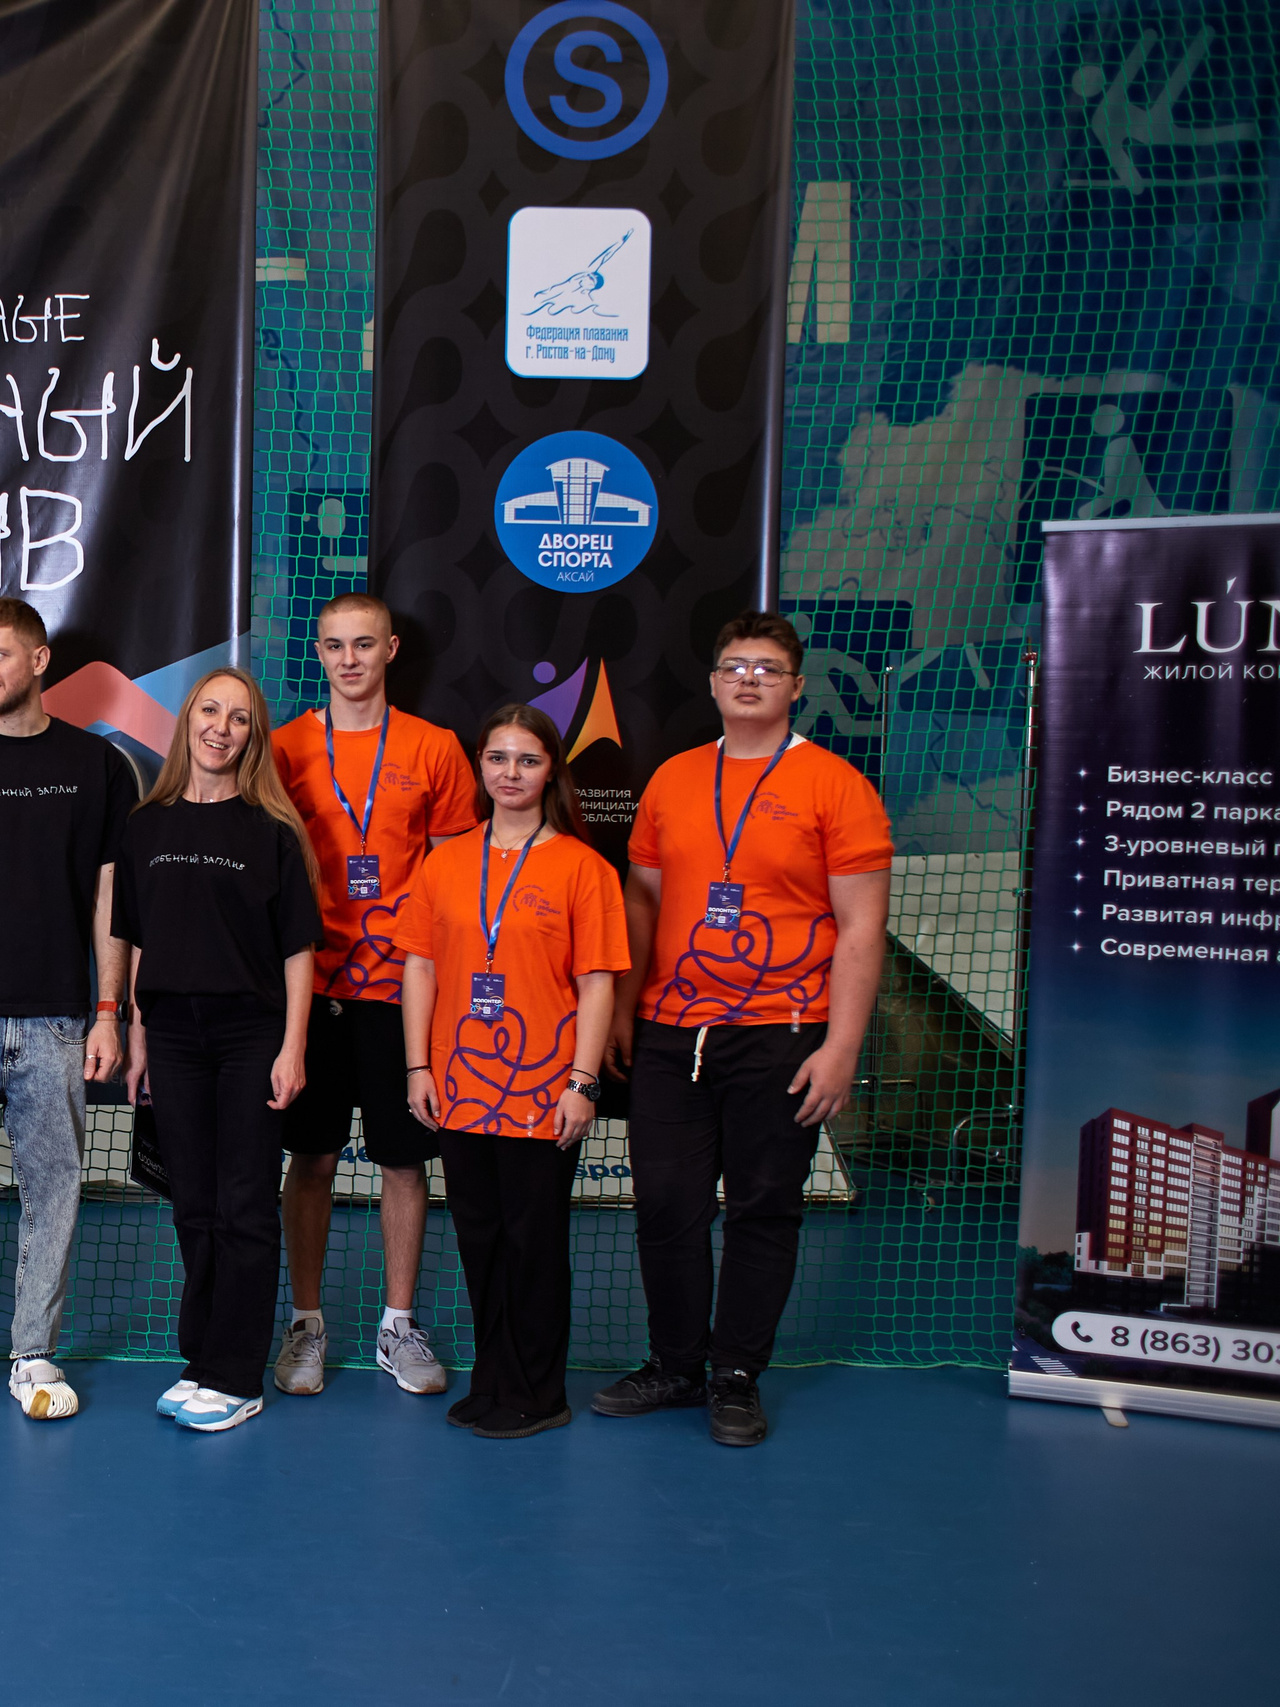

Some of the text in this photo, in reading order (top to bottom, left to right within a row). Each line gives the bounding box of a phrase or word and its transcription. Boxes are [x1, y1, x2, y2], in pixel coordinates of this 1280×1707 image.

[526, 324, 628, 343] Федерация плавания
[536, 344, 615, 363] Ростов-на-Дону
[538, 533, 613, 550] ДВОРЕЦ
[538, 551, 613, 568] СПОРТА
[556, 570, 595, 583] АКСАЙ
[1143, 662, 1280, 680] ЖИЛОЙ КО
[1107, 766, 1273, 785] Бизнес-класс
[1106, 800, 1183, 820] Рядом
[1190, 802, 1205, 819] 2
[1104, 835, 1266, 857] 3-уровневый
[1103, 869, 1235, 891] Приватная
[1102, 904, 1213, 924] Развитая
[1100, 938, 1269, 962] Современная
[1111, 1326, 1129, 1347] 8
[1140, 1328, 1220, 1363] (863)
